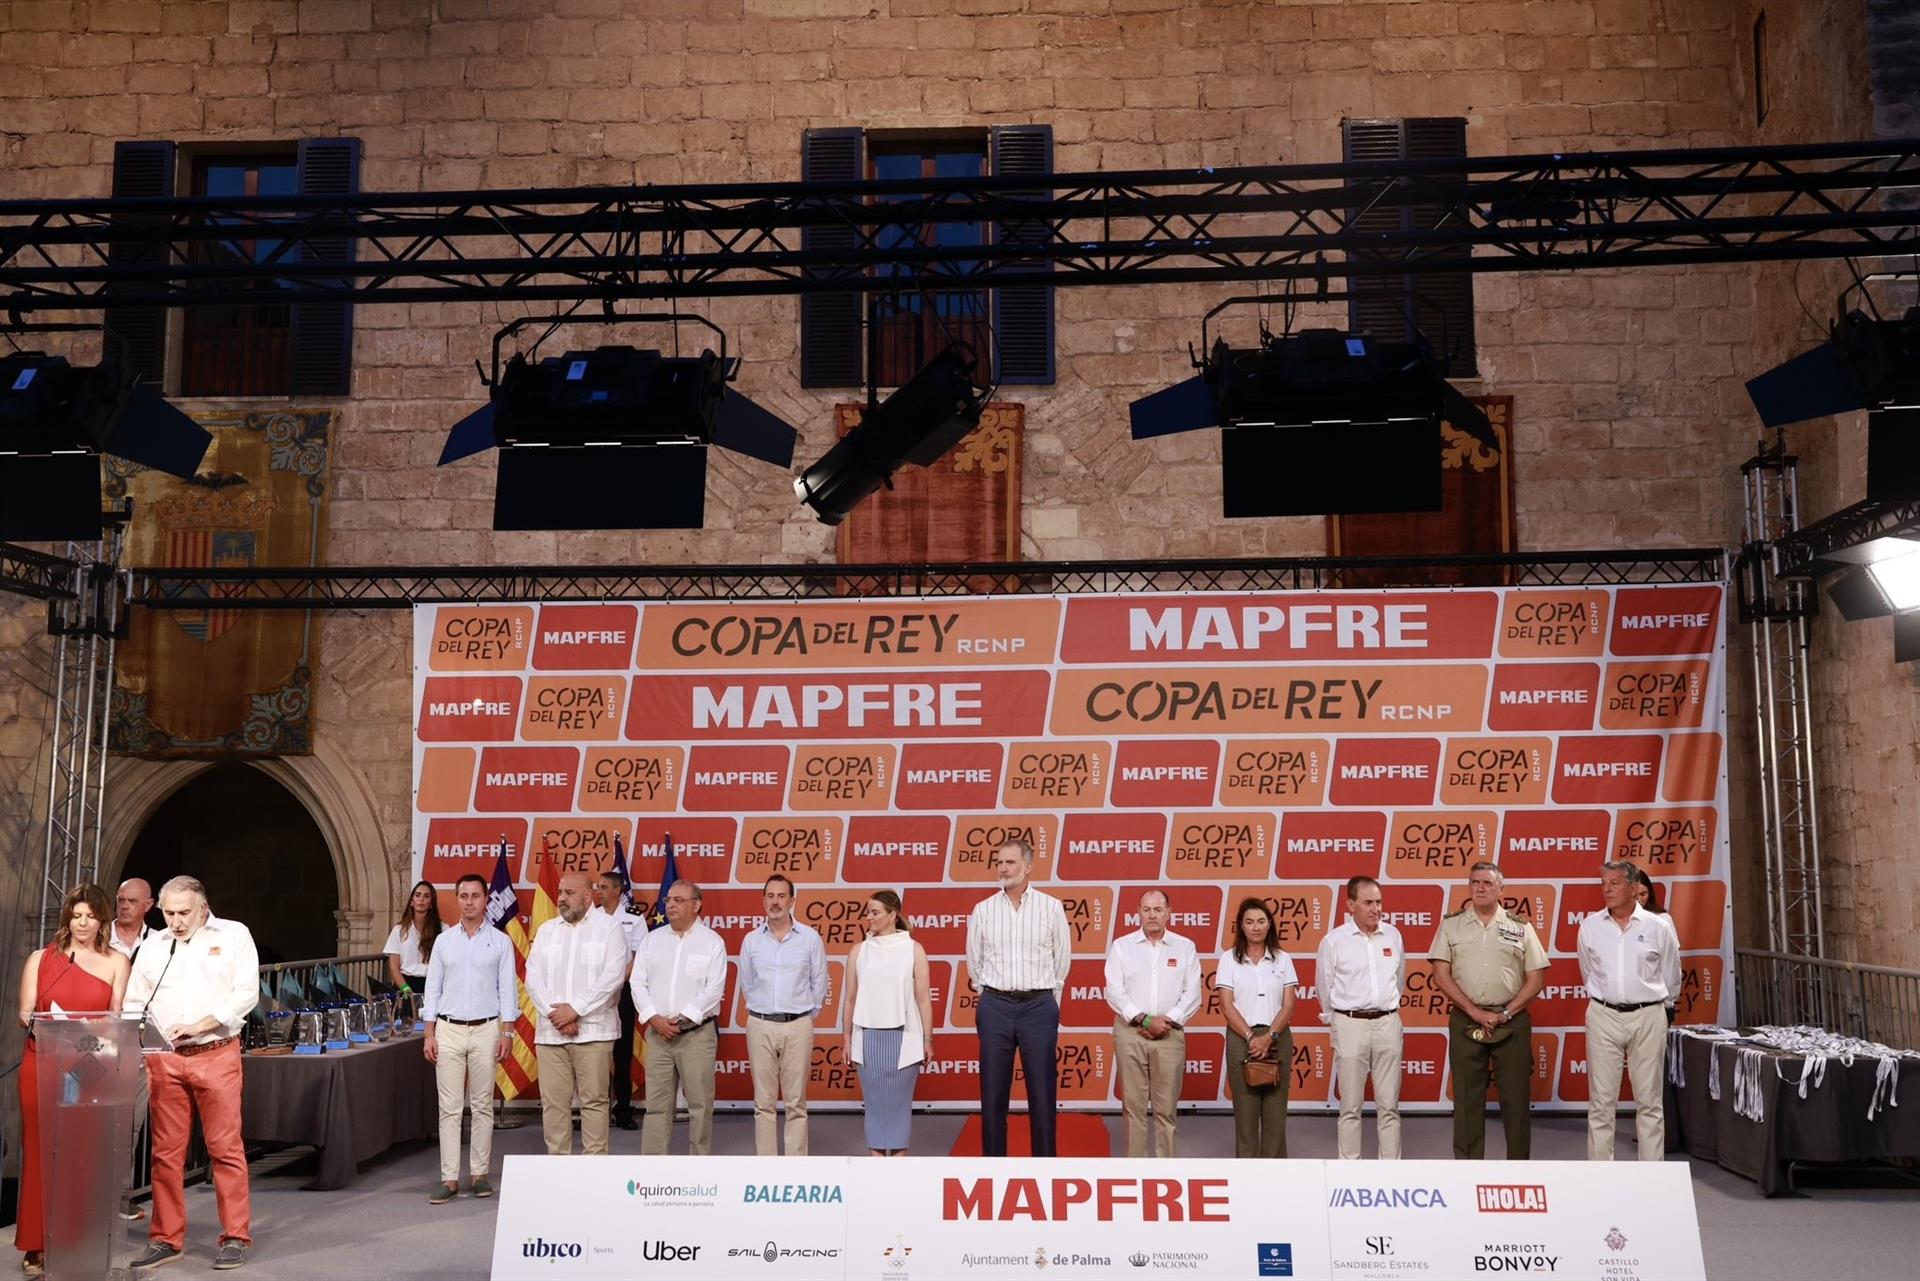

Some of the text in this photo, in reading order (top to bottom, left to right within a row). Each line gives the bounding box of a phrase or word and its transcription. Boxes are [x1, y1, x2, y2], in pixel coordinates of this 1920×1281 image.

[1516, 602, 1586, 623] COPA
[1622, 613, 1709, 628] MAPFRE
[446, 618, 511, 637] COPA
[544, 631, 626, 644] MAPFRE
[672, 614, 1025, 656] COPA DEL REY RCNP
[1129, 605, 1428, 650] MAPFRE
[1508, 626, 1586, 646] DEL REY
[438, 639, 510, 659] DEL REY
[1617, 673, 1686, 693] COPA
[538, 688, 603, 707] COPA
[692, 683, 982, 728] MAPFRE
[1087, 680, 1451, 722] COPA DEL REY RCNP
[1500, 690, 1588, 704] MAPFRE
[1609, 697, 1686, 717] DEL REY
[430, 702, 510, 715] MAPFRE
[530, 710, 602, 729] DEL REY
[595, 758, 661, 778] COPA
[805, 757, 873, 776] COPA
[1020, 753, 1088, 773] COPA
[1237, 752, 1306, 772] COPA
[1458, 750, 1528, 770] COPA
[1564, 762, 1652, 777] MAPFRE
[486, 773, 567, 786] MAPFRE
[695, 772, 778, 785] MAPFRE
[908, 769, 991, 783] MAPFRE
[1123, 767, 1208, 780] MAPFRE
[1341, 765, 1428, 779] MAPFRE
[587, 781, 660, 800] DEL REY
[798, 779, 872, 799] DEL REY
[1012, 777, 1088, 796] DEL REY
[1229, 774, 1306, 794] DEL REY
[1450, 773, 1528, 793] DEL REY
[546, 830, 608, 849] COPA
[752, 829, 820, 848] COPA
[967, 827, 1035, 847] COPA
[1183, 825, 1252, 845] COPA
[1403, 824, 1474, 844] COPA
[1627, 821, 1696, 841] COPA
[854, 842, 938, 856] MAPFRE
[1069, 840, 1154, 853] MAPFRE
[1288, 839, 1374, 852] MAPFRE
[1510, 837, 1598, 851] MAPFRE
[1619, 844, 1696, 864] DEL REY
[562, 852, 608, 872] REY
[745, 852, 820, 871] DEL REY
[959, 851, 984, 862] DEL
[1176, 848, 1252, 868] DEL REY
[1396, 847, 1474, 867] DEL REY
[1094, 899, 1102, 930] RCNP
[1124, 912, 1210, 927] MFRE
[1313, 898, 1321, 929] RCNP
[1536, 897, 1544, 929] RCNP
[1278, 921, 1309, 941] EY
[1703, 967, 1711, 1000] RCNP
[1316, 1045, 1324, 1078] RCNP
[1539, 1046, 1547, 1078] RCNP
[828, 1069, 857, 1088] RE
[943, 1178, 1230, 1222] MAPFRE
[643, 1241, 701, 1261] Uber
[728, 1249, 838, 1257] SAIL RACING
[1365, 1236, 1394, 1255] SE
[1485, 1244, 1546, 1253] MARRIOTT
[962, 1254, 1111, 1267] Ajuntament de Palma
[1153, 1261, 1198, 1269] NACIONAL
[1474, 1256, 1558, 1272] BONVOY
